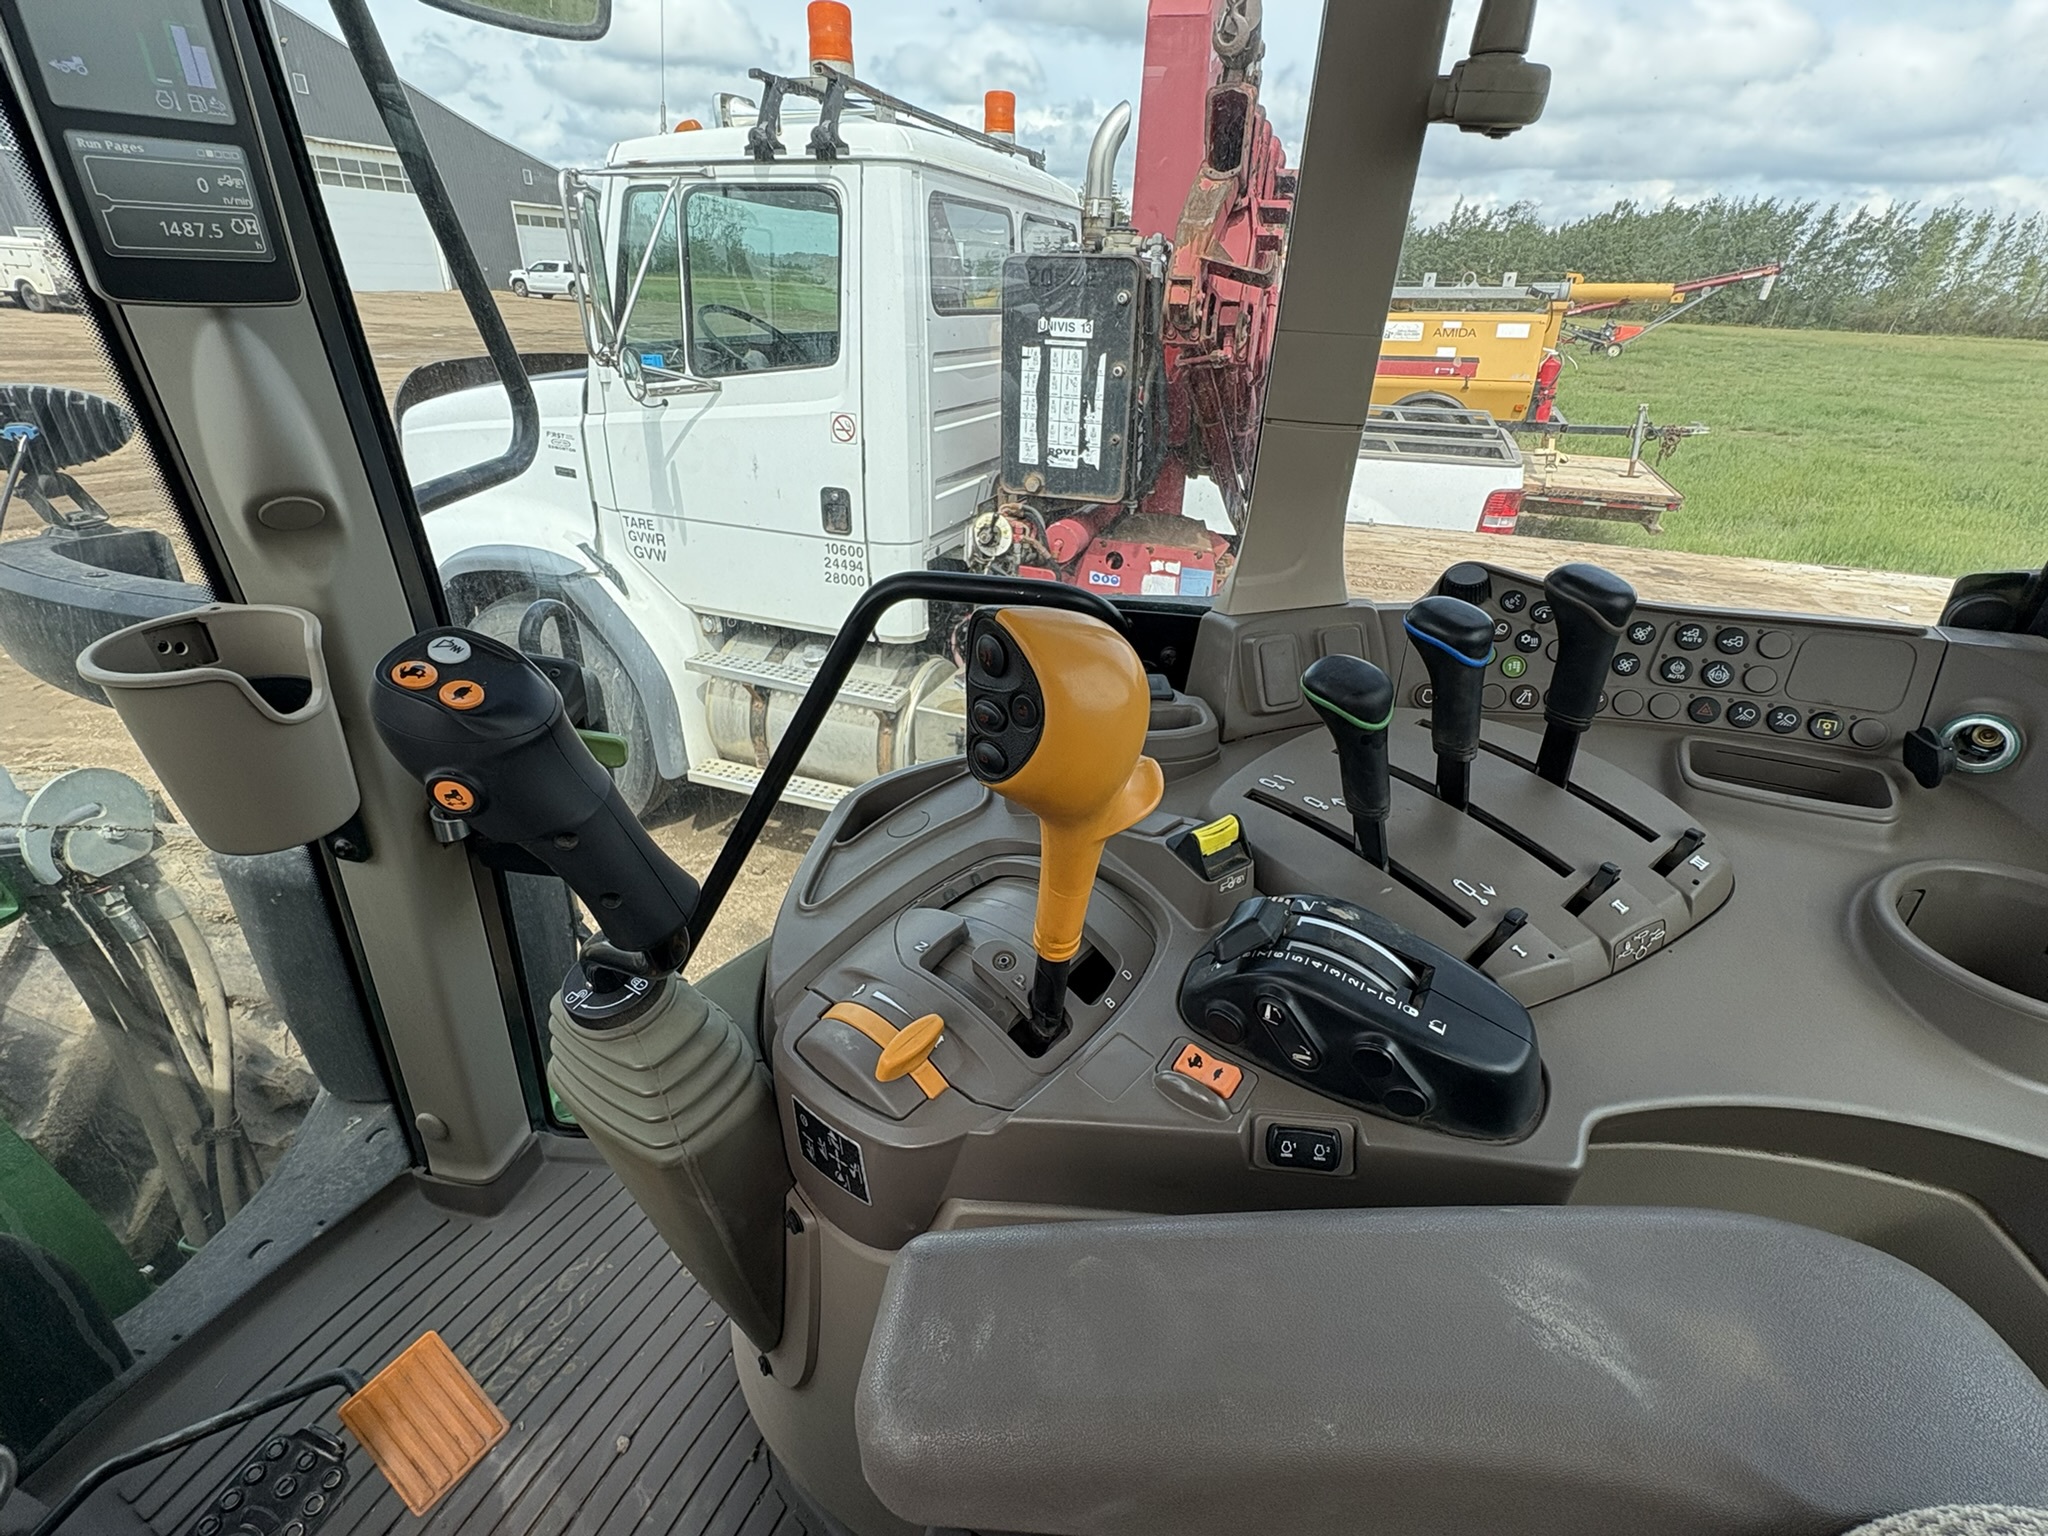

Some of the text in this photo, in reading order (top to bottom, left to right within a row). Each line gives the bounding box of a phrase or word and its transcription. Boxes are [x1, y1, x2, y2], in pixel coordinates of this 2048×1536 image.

[76, 138, 145, 154] Run Pages
[197, 177, 209, 193] 0
[223, 197, 251, 207] n/min
[160, 221, 224, 239] 1487.5
[1039, 320, 1092, 334] UNIVIS 13
[1433, 328, 1477, 338] AMIDA
[623, 515, 654, 531] TARE
[628, 531, 666, 547] GVWR
[634, 546, 667, 562] GVW
[824, 543, 864, 559] 10600
[824, 557, 864, 572] 24494
[824, 572, 865, 587] 28000
[1681, 635, 1703, 643] AUTO
[1667, 673, 1685, 681] AUTO
[1688, 855, 1711, 871] III
[1610, 899, 1630, 915] II
[914, 941, 929, 953] N
[1511, 944, 1528, 958] I
[1121, 969, 1133, 982] D
[1291, 954, 1303, 963] 5
[1311, 960, 1322, 968] 4
[1329, 968, 1341, 977] 3
[1348, 977, 1359, 987] 2
[1367, 987, 1378, 995] 1
[1385, 996, 1396, 1005] 0
[1104, 997, 1116, 1009] B
